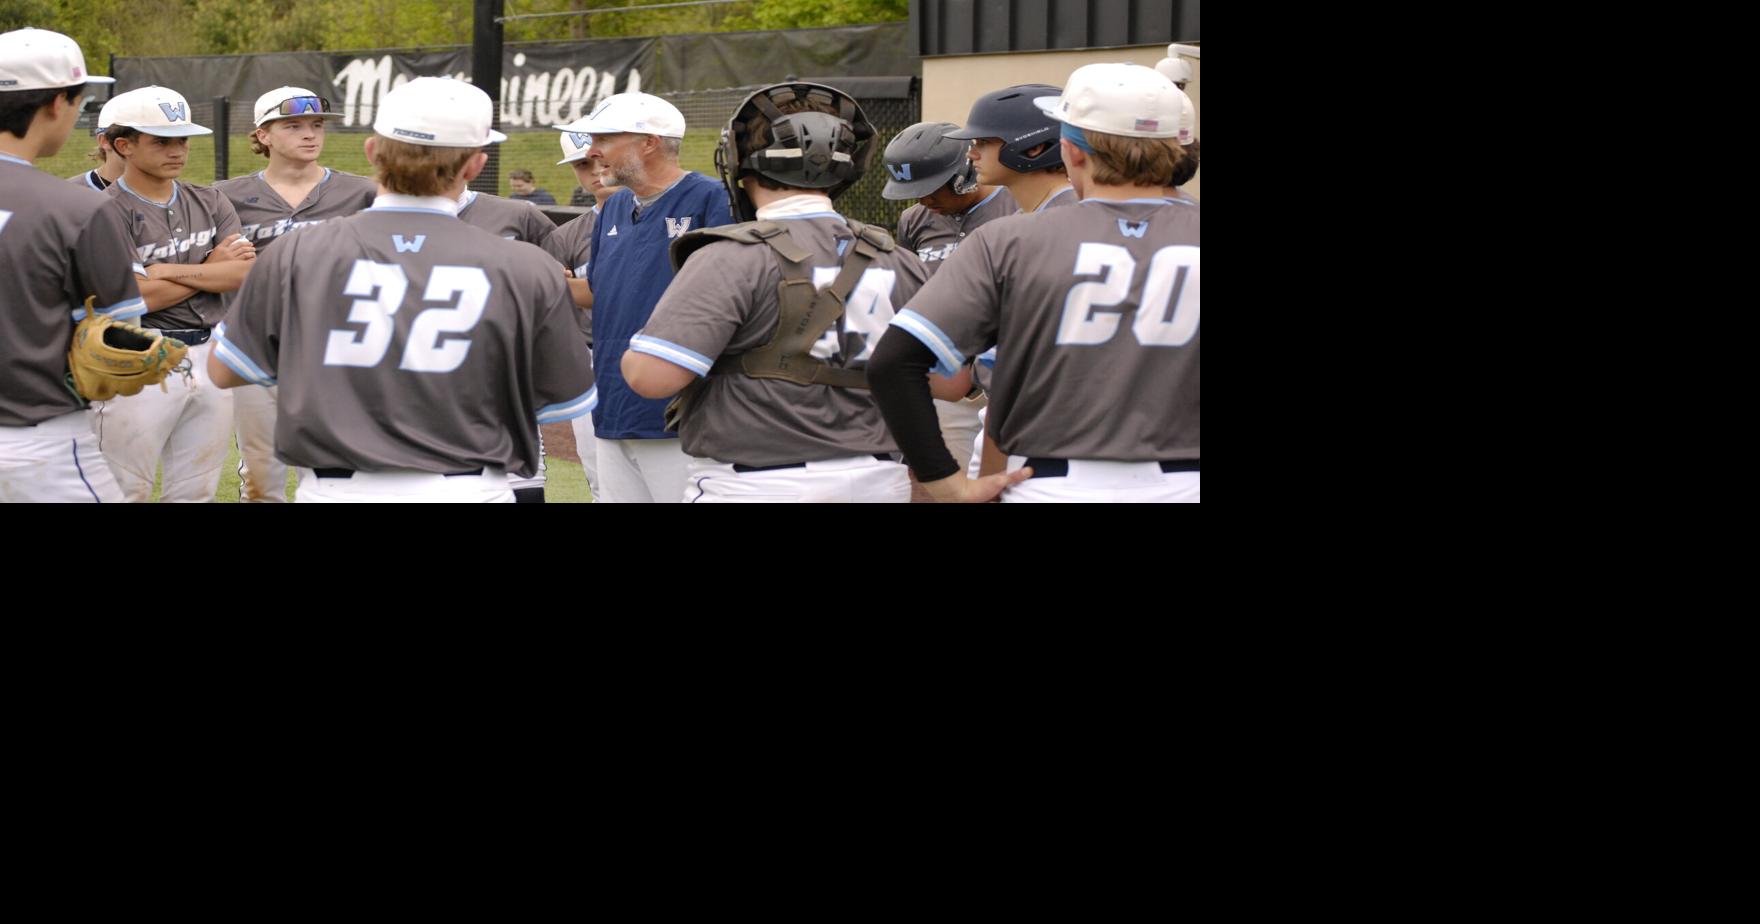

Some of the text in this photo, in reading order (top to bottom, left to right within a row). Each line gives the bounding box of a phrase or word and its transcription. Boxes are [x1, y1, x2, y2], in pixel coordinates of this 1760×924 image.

[158, 101, 186, 122] W
[887, 163, 912, 181] W
[664, 216, 692, 238] W
[1117, 217, 1150, 239] W
[391, 234, 427, 253] W
[1054, 241, 1200, 347] 20
[322, 257, 492, 374] 32
